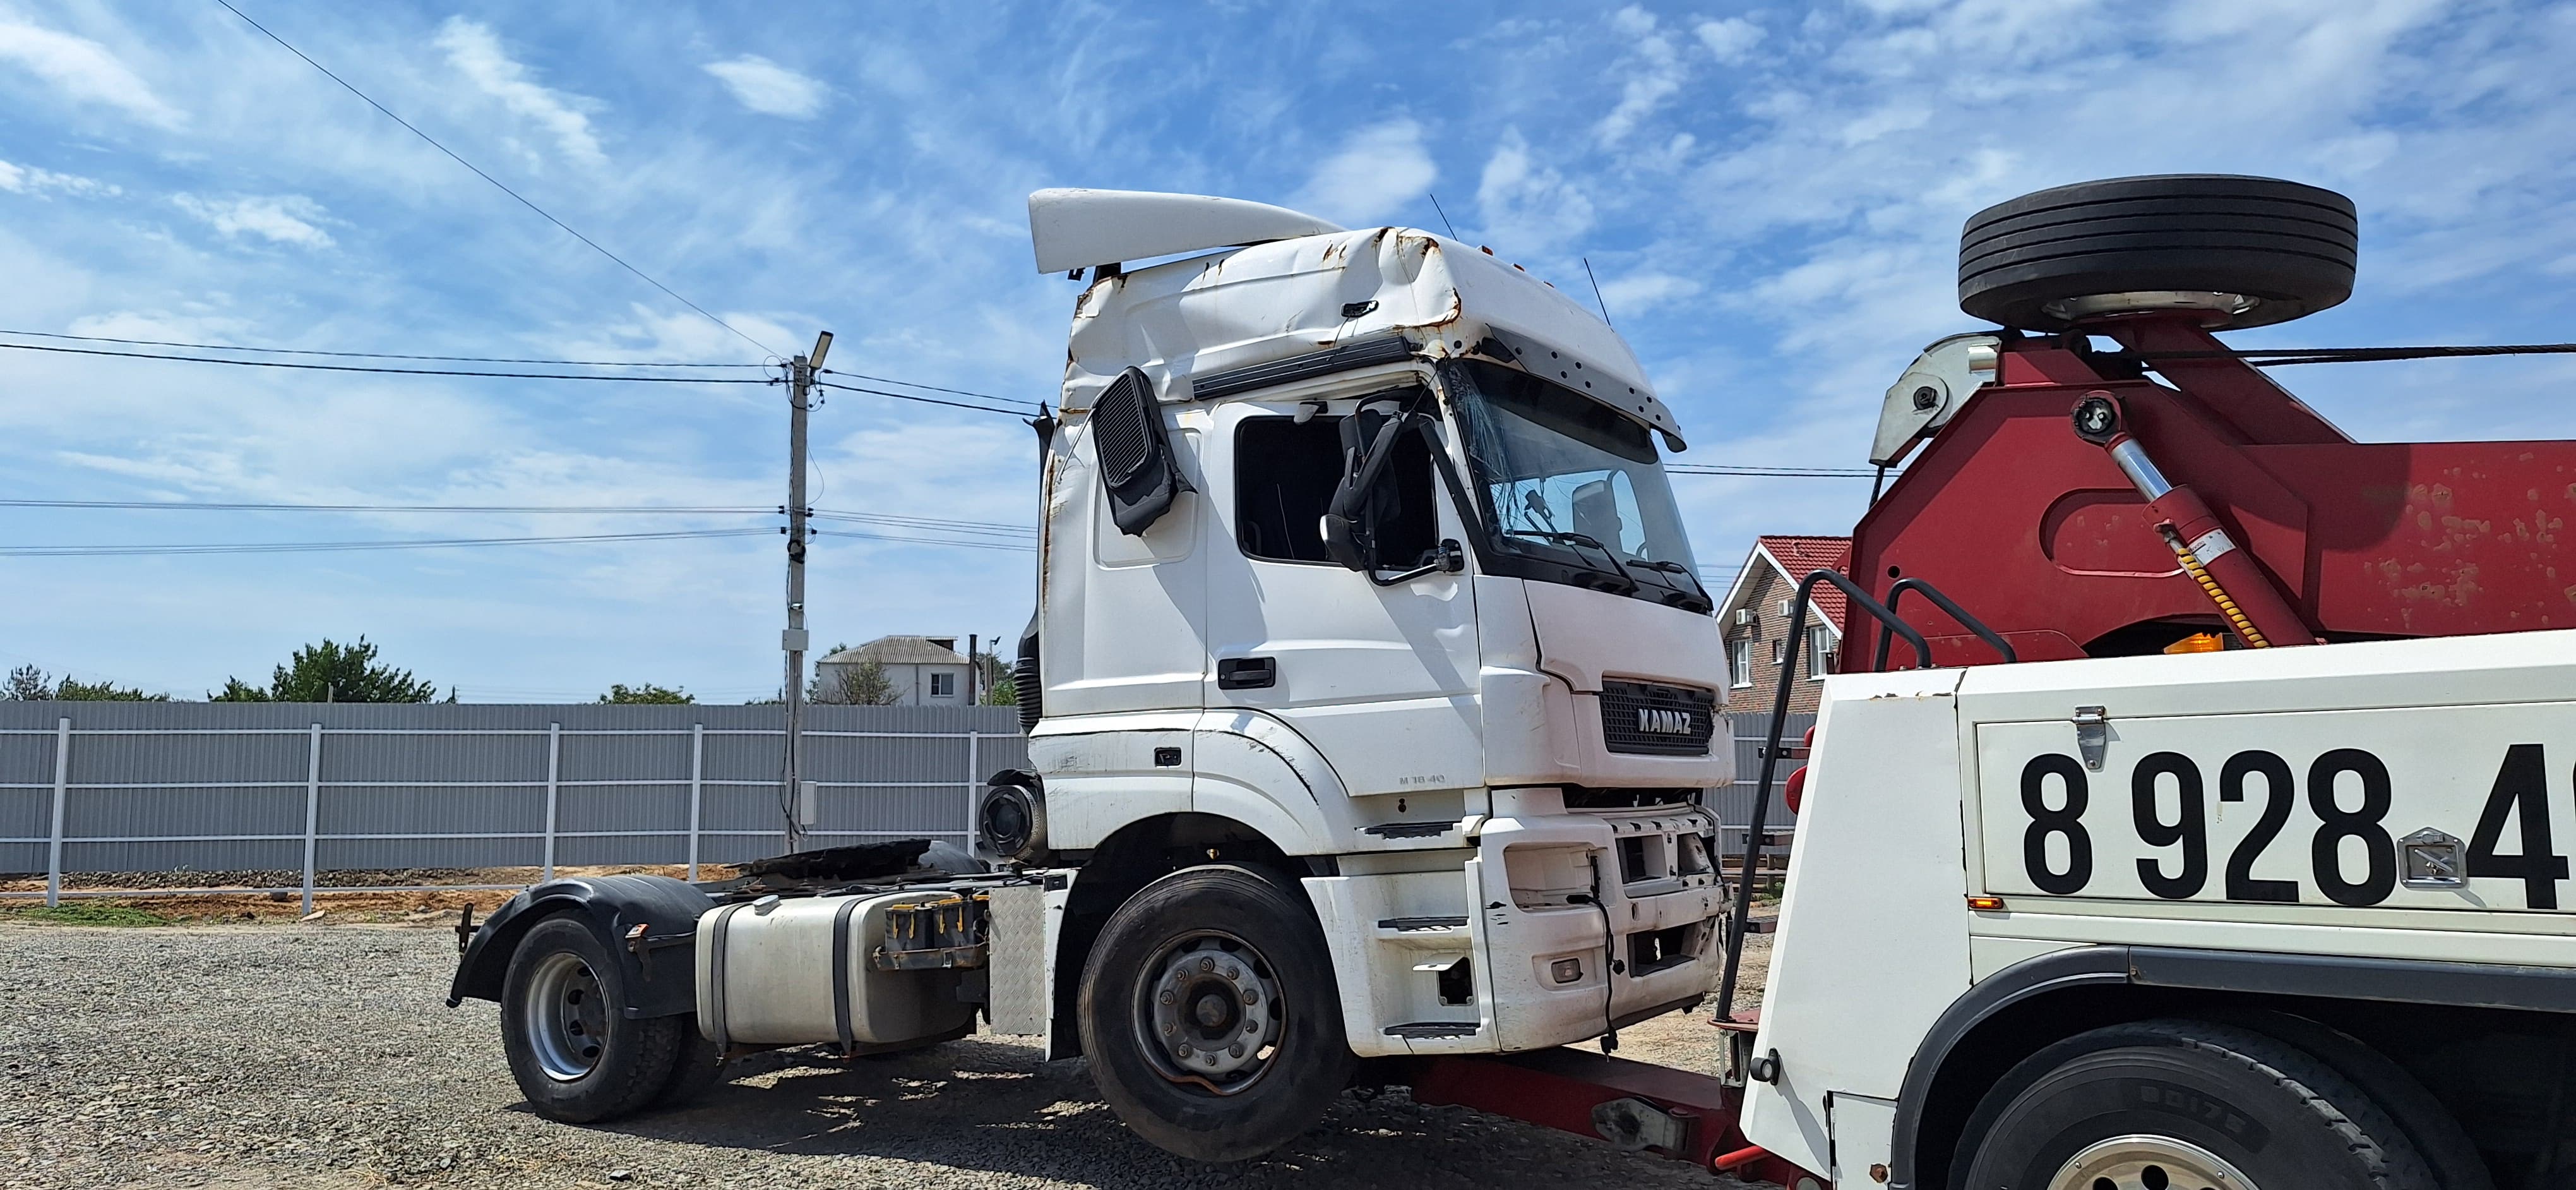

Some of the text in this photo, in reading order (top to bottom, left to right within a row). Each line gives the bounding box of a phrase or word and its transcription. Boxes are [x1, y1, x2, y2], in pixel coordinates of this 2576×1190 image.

[1638, 708, 1691, 734] KAMAZ
[2021, 743, 2576, 910] 8 928 4
